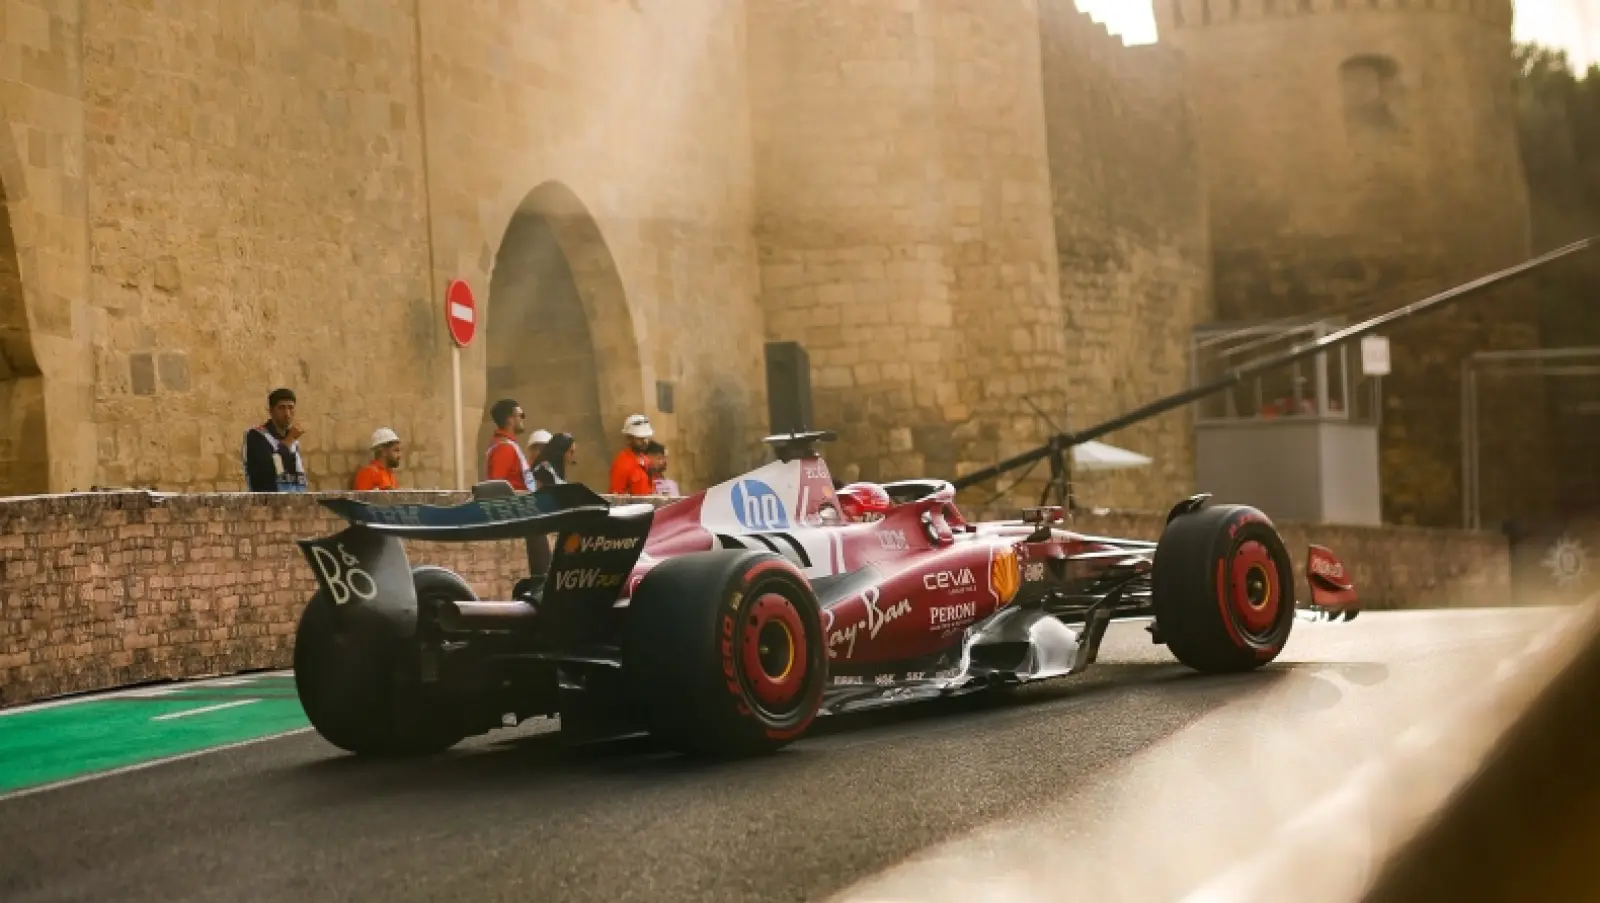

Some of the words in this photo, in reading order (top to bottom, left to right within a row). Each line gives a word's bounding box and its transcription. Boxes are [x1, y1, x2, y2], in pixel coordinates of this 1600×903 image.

[738, 480, 783, 529] hp
[580, 535, 639, 553] V-Power
[556, 568, 601, 591] VGW
[929, 601, 976, 625] PERONI
